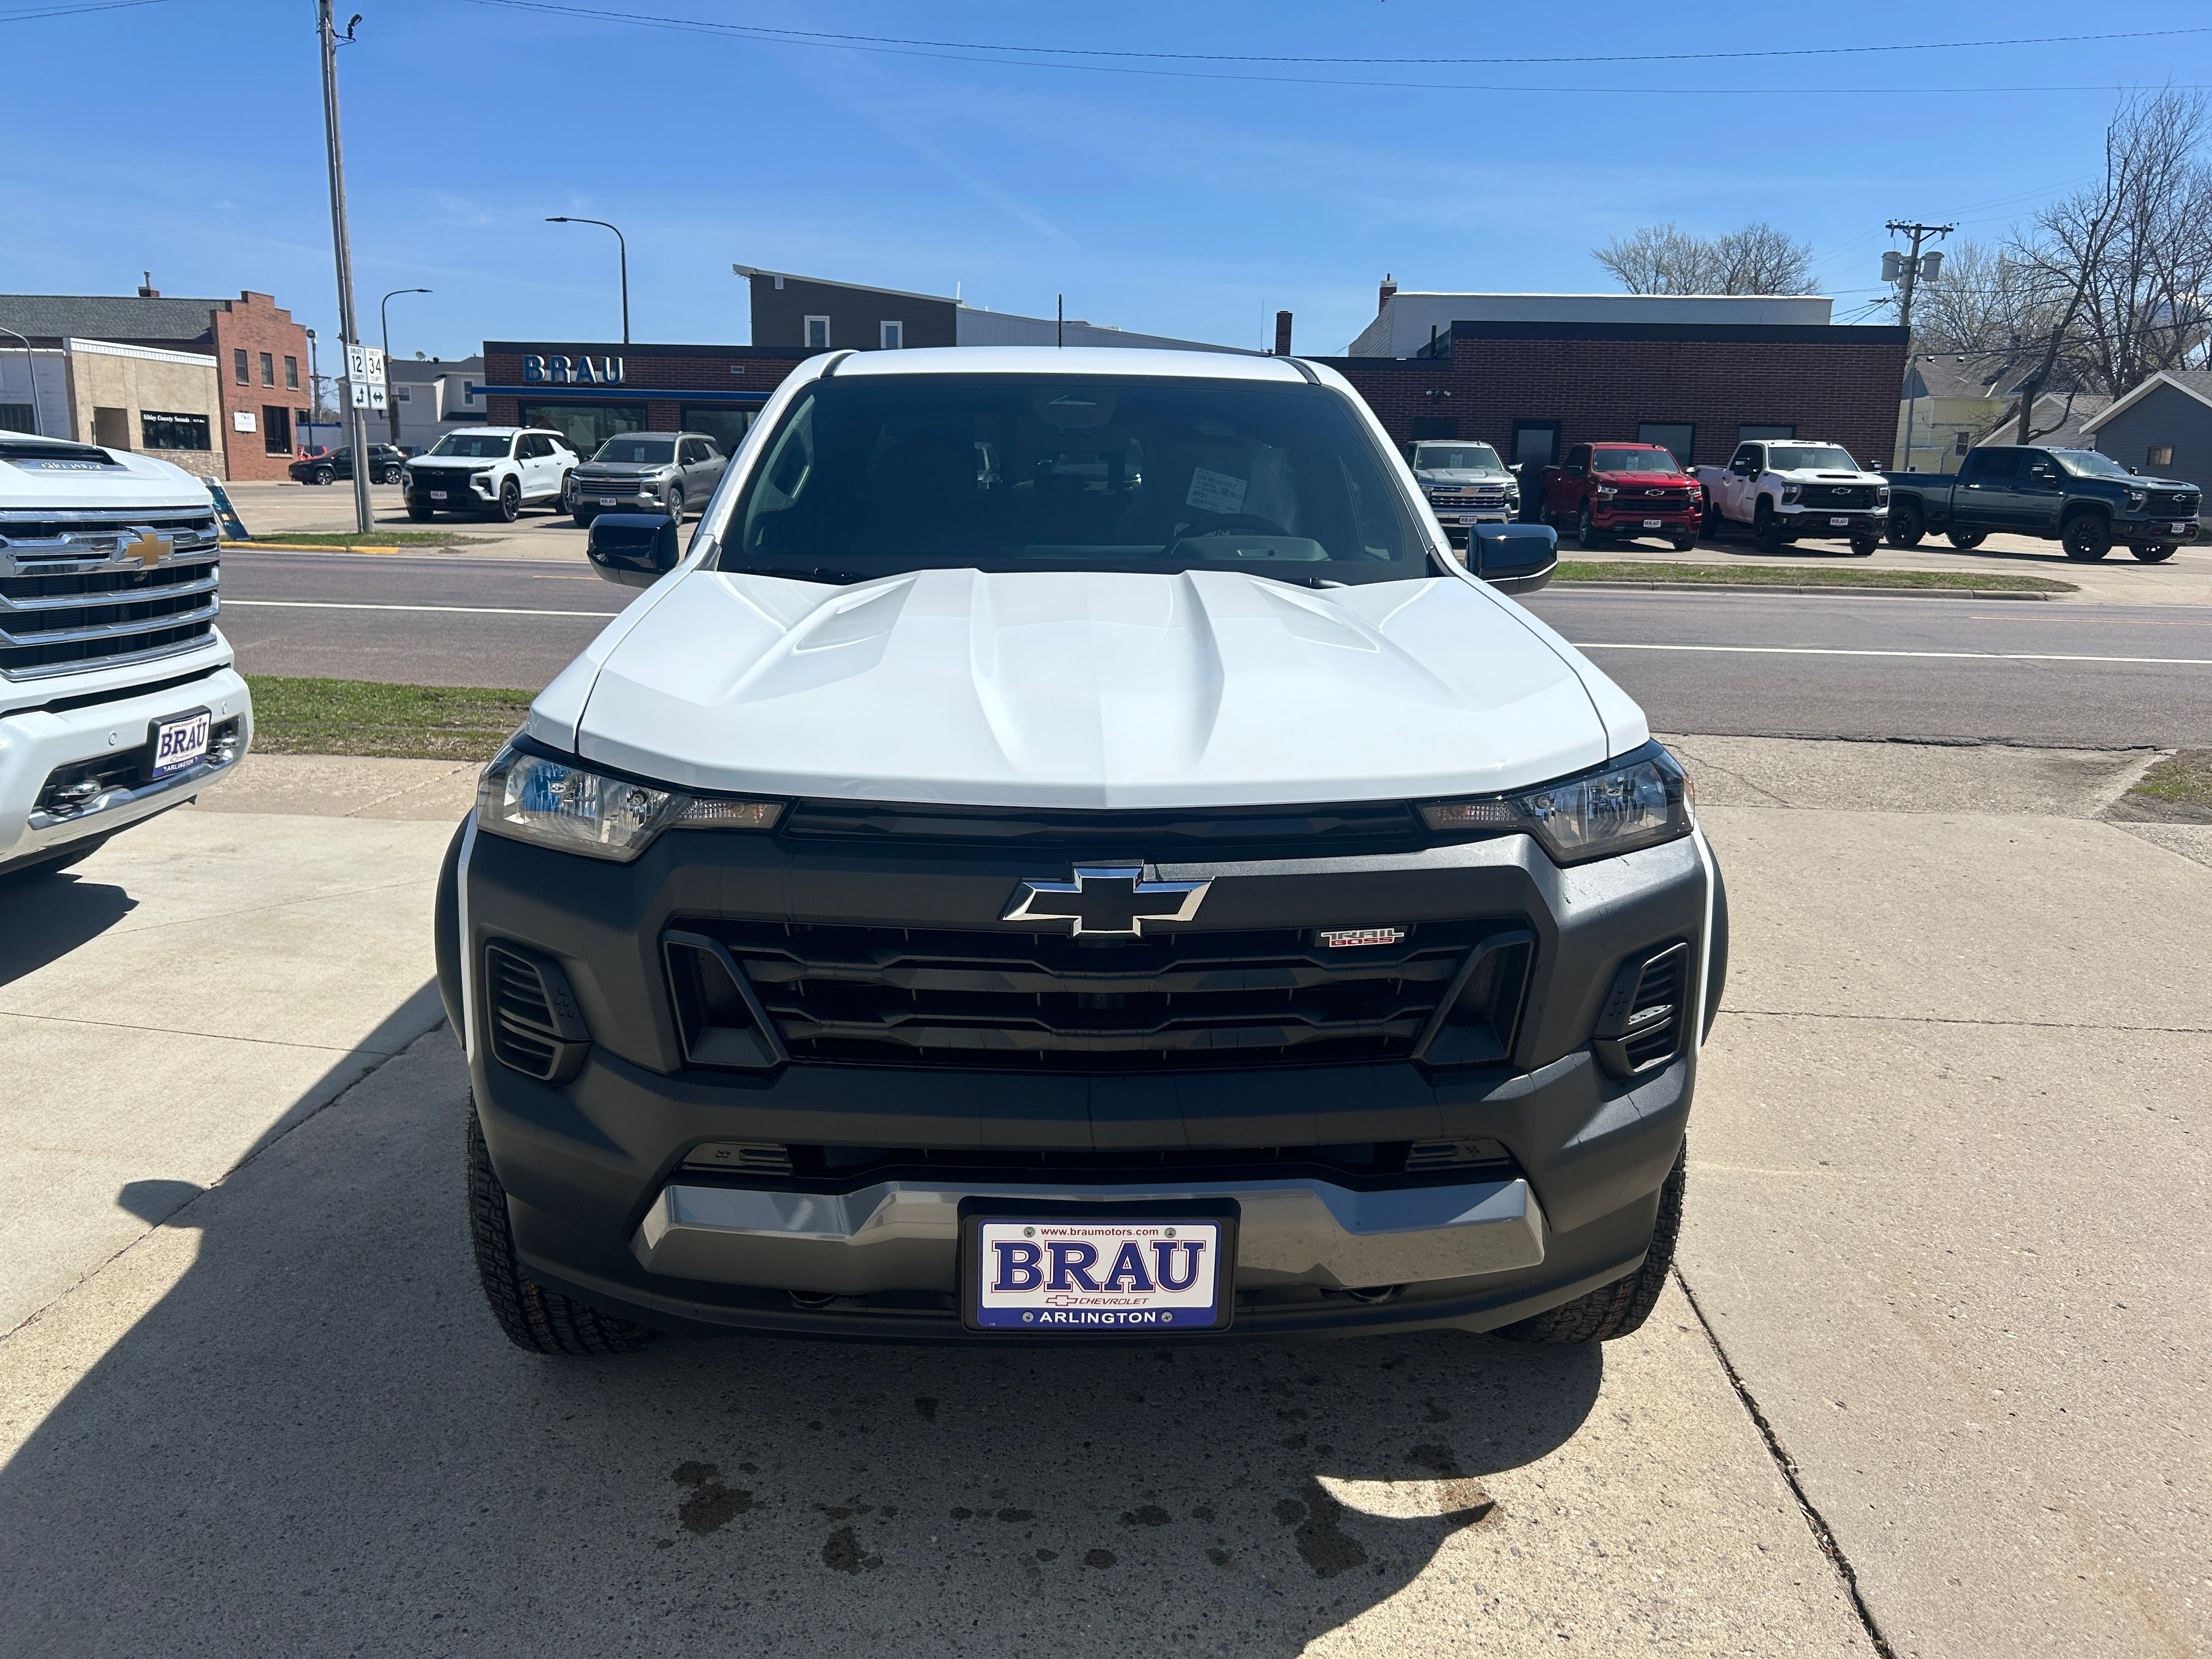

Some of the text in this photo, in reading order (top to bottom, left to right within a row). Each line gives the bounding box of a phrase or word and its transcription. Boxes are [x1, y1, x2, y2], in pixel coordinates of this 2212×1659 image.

[352, 356, 363, 373] 12
[369, 358, 381, 374] 34
[524, 355, 624, 385] BRAU
[159, 722, 207, 759] BRAU
[167, 759, 194, 771] ARLINGTON
[1322, 929, 1402, 939] TRAIL
[1331, 937, 1393, 946] BOSS
[1041, 1227, 1159, 1237] www.braumotors.com
[991, 1240, 1206, 1293] BRAU
[1039, 1312, 1156, 1324] ARLINGTON
